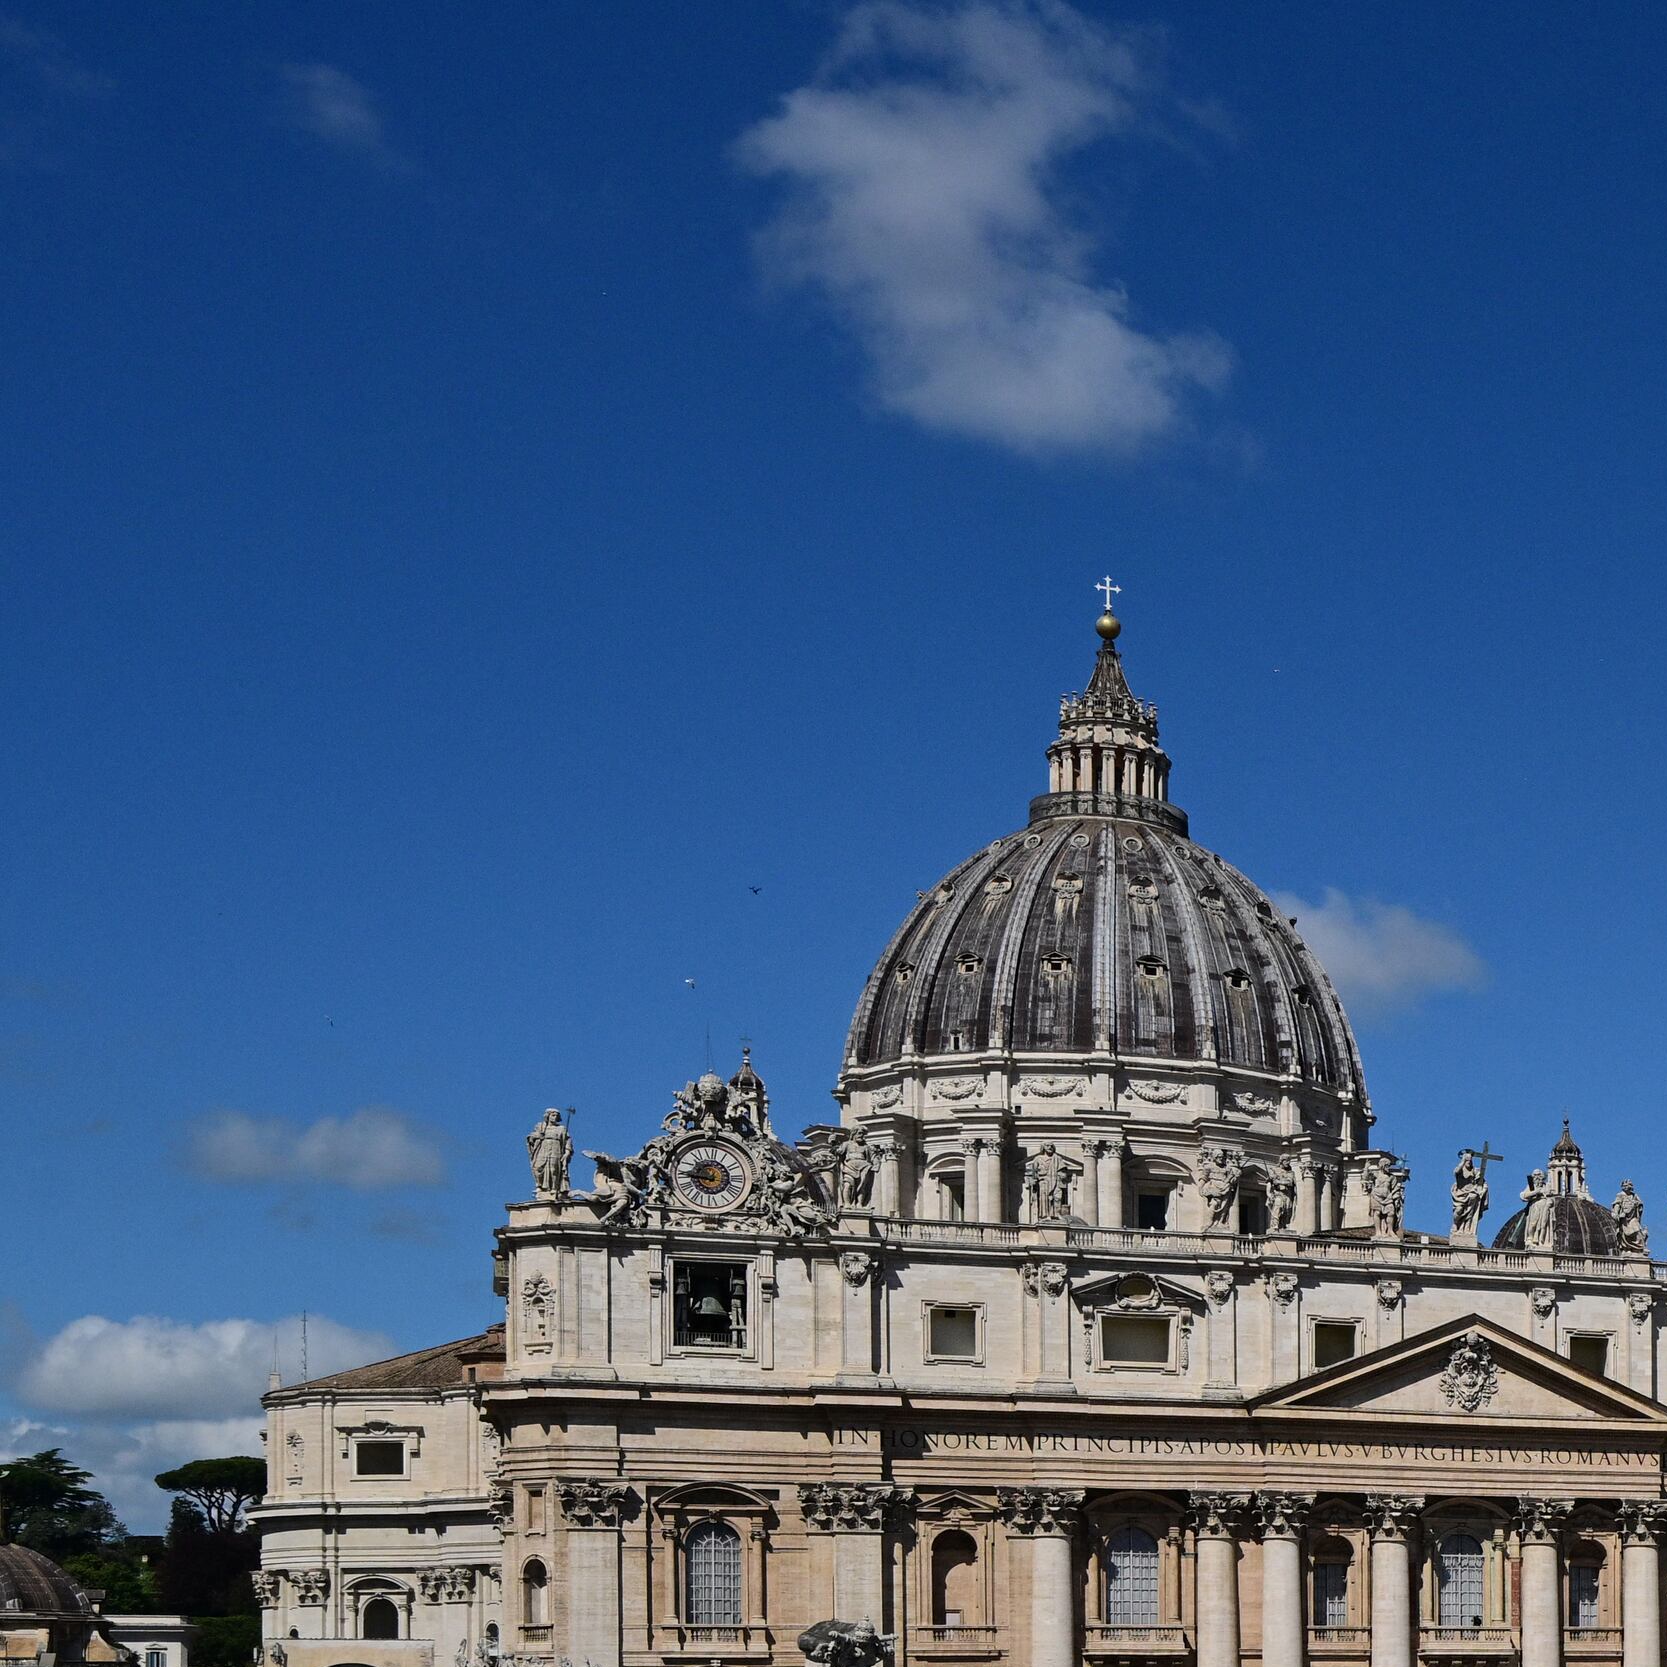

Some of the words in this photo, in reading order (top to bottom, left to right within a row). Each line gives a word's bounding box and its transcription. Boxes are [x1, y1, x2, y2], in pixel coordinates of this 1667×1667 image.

[836, 1427, 869, 1444] IN
[883, 1429, 1026, 1452] HONOREM
[1037, 1432, 1174, 1454] PRINCIPIS
[1181, 1437, 1264, 1457] APOST
[1268, 1438, 1354, 1458] PAVLVS
[1359, 1442, 1374, 1458] V
[1381, 1442, 1533, 1465] BVRGHESIVS
[1541, 1447, 1660, 1467] ROMANVS
